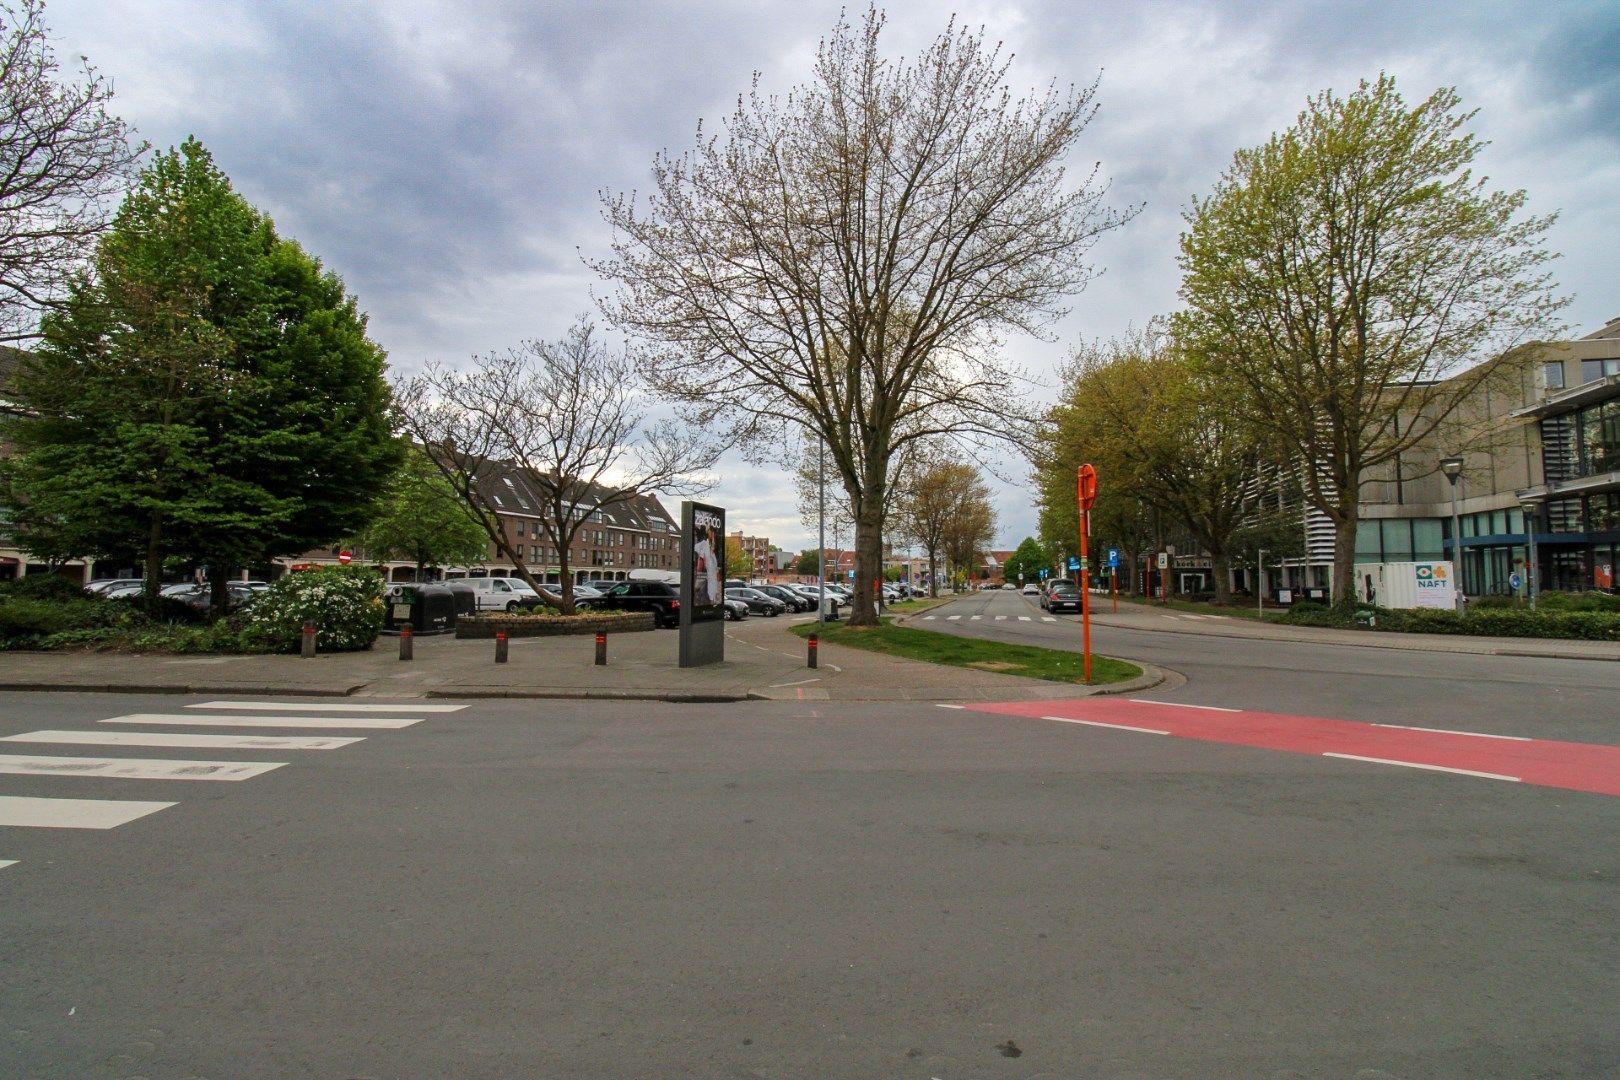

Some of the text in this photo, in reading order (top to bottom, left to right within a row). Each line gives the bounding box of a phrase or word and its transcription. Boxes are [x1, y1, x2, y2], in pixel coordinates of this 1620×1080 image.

[695, 515, 721, 529] zalando
[1110, 551, 1117, 561] P
[1418, 580, 1447, 588] NAFT
